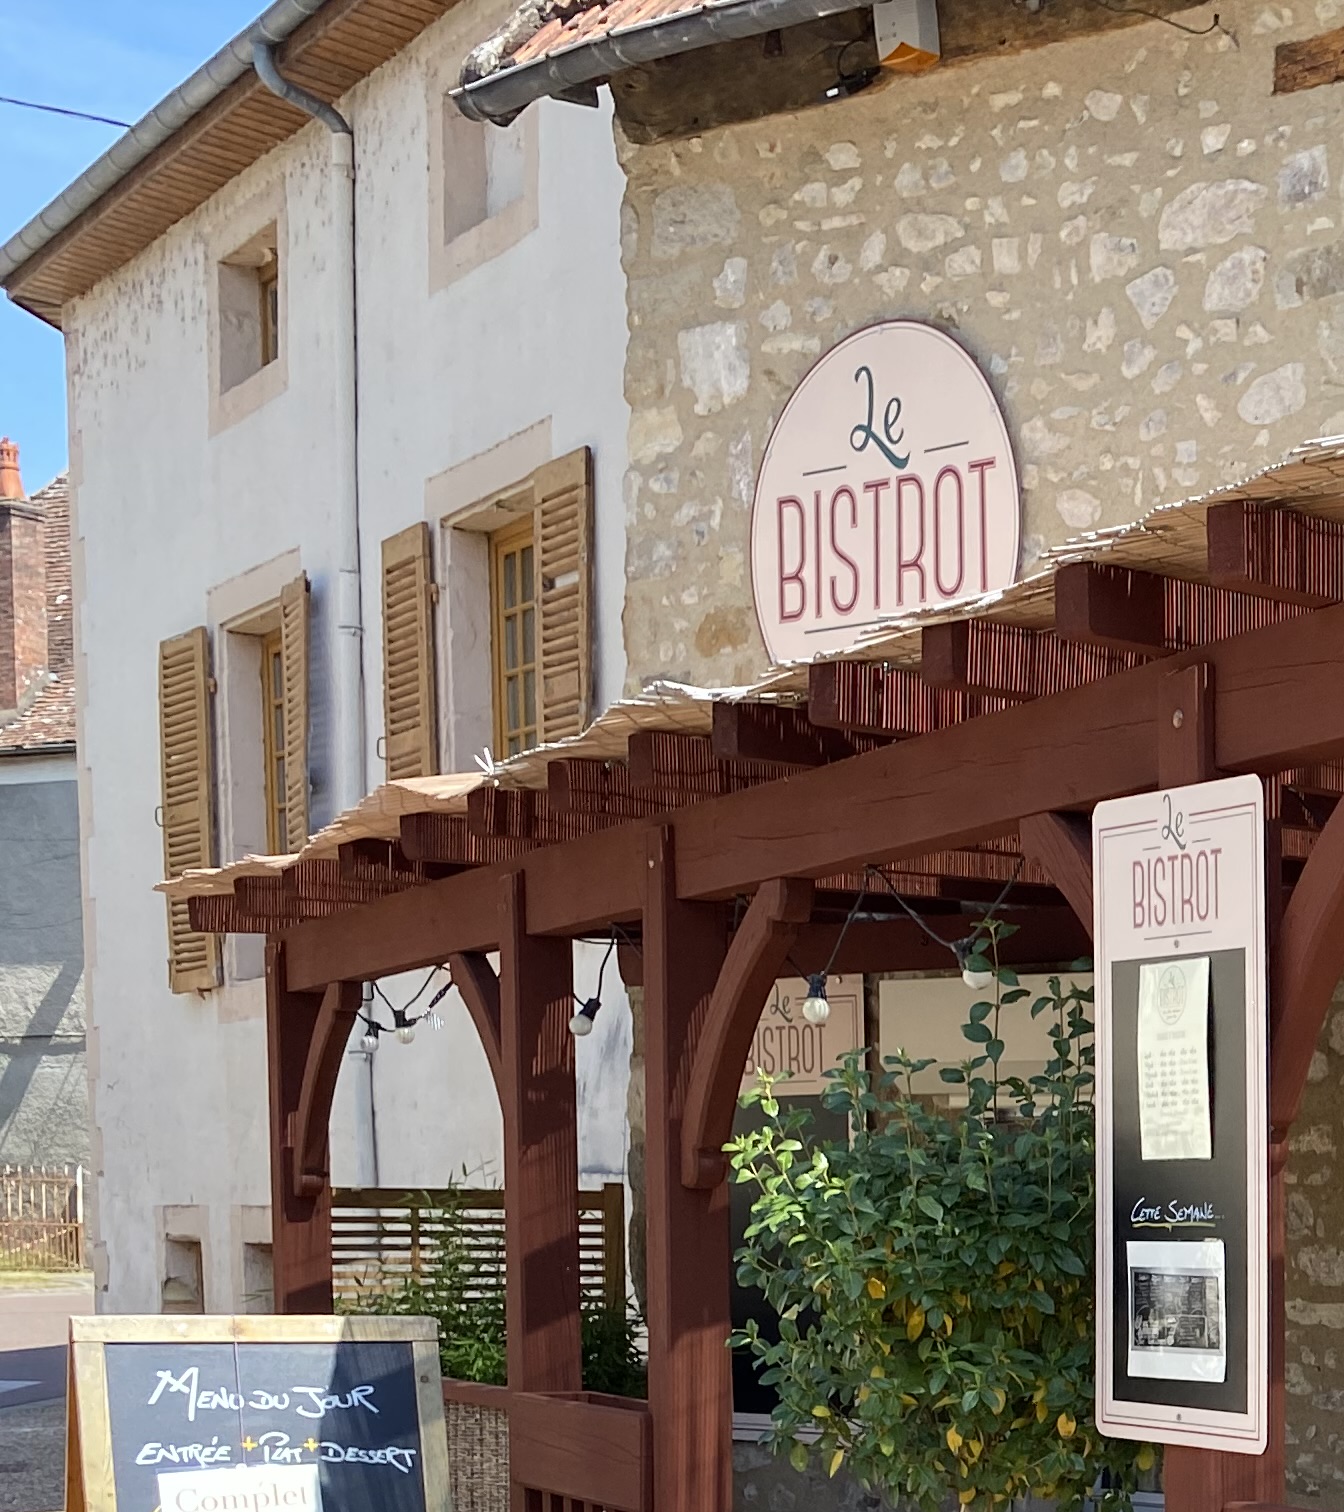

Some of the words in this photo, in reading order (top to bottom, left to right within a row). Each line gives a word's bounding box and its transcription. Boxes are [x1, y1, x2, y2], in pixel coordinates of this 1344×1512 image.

[850, 365, 911, 470] Le
[776, 456, 996, 624] BISTROT
[1161, 793, 1187, 851] Le
[1132, 847, 1222, 929] BISTROT
[769, 983, 793, 1023] Le
[135, 1435, 232, 1469] ENTRÉE
[320, 1441, 417, 1474] DESSERT
